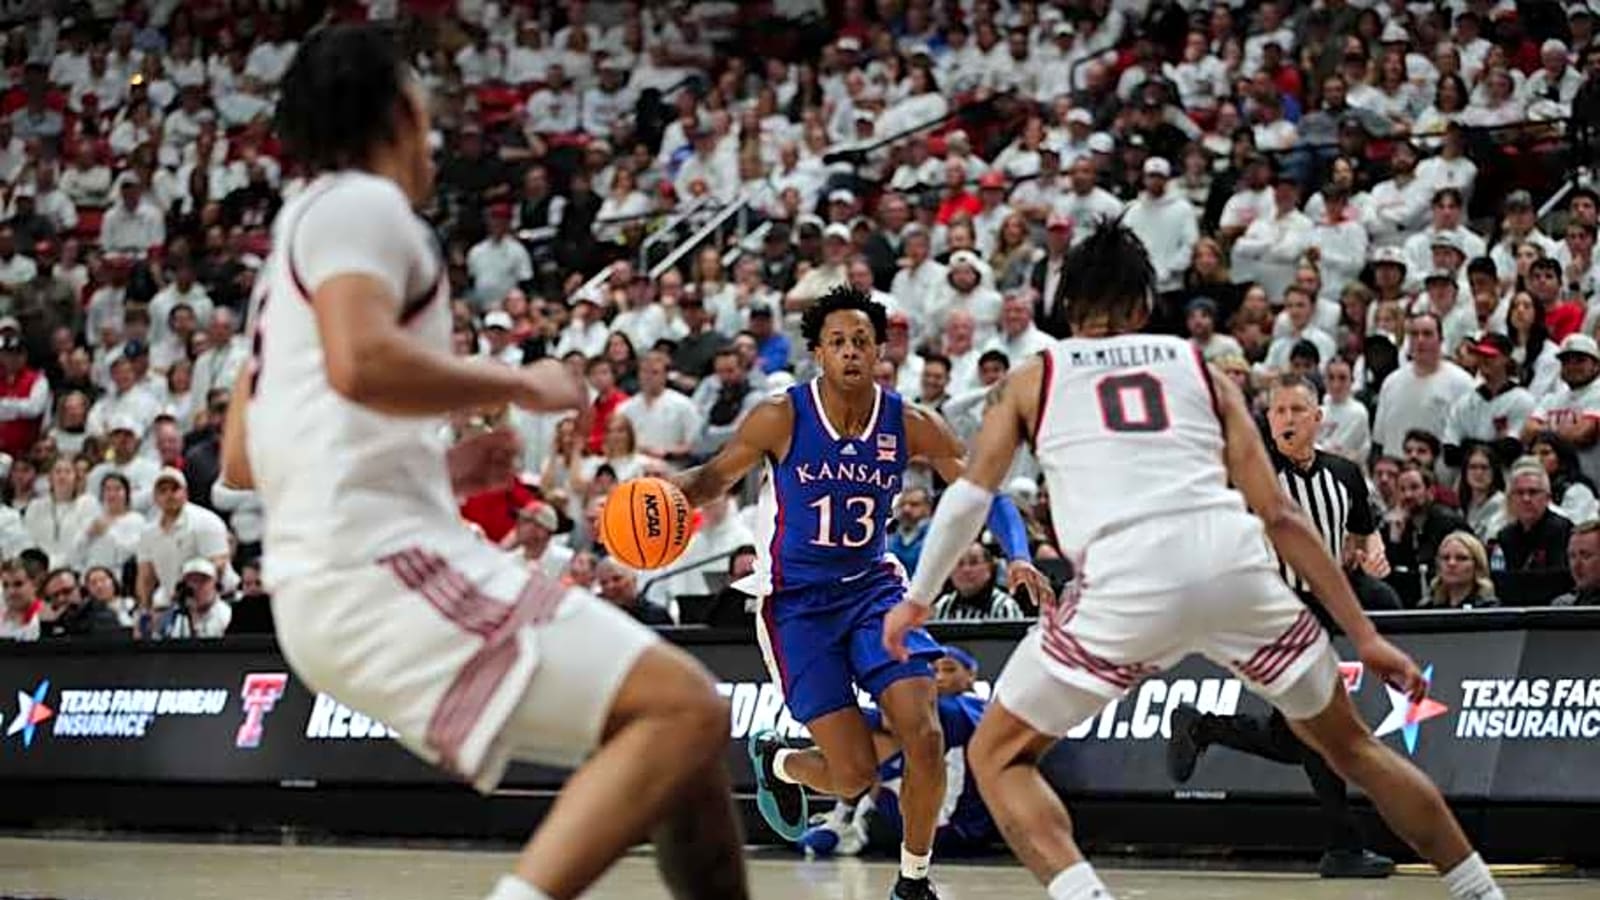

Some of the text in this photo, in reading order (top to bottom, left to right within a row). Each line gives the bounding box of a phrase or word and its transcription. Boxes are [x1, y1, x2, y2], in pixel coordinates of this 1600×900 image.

[1096, 371, 1170, 432] 0
[796, 462, 897, 489] KANSAS
[644, 493, 661, 537] NCAA
[808, 495, 876, 547] 13
[60, 689, 228, 714] TEXAS FARM BUREAU
[1461, 679, 1550, 708] TEXAS
[53, 713, 149, 737] INSURANCE
